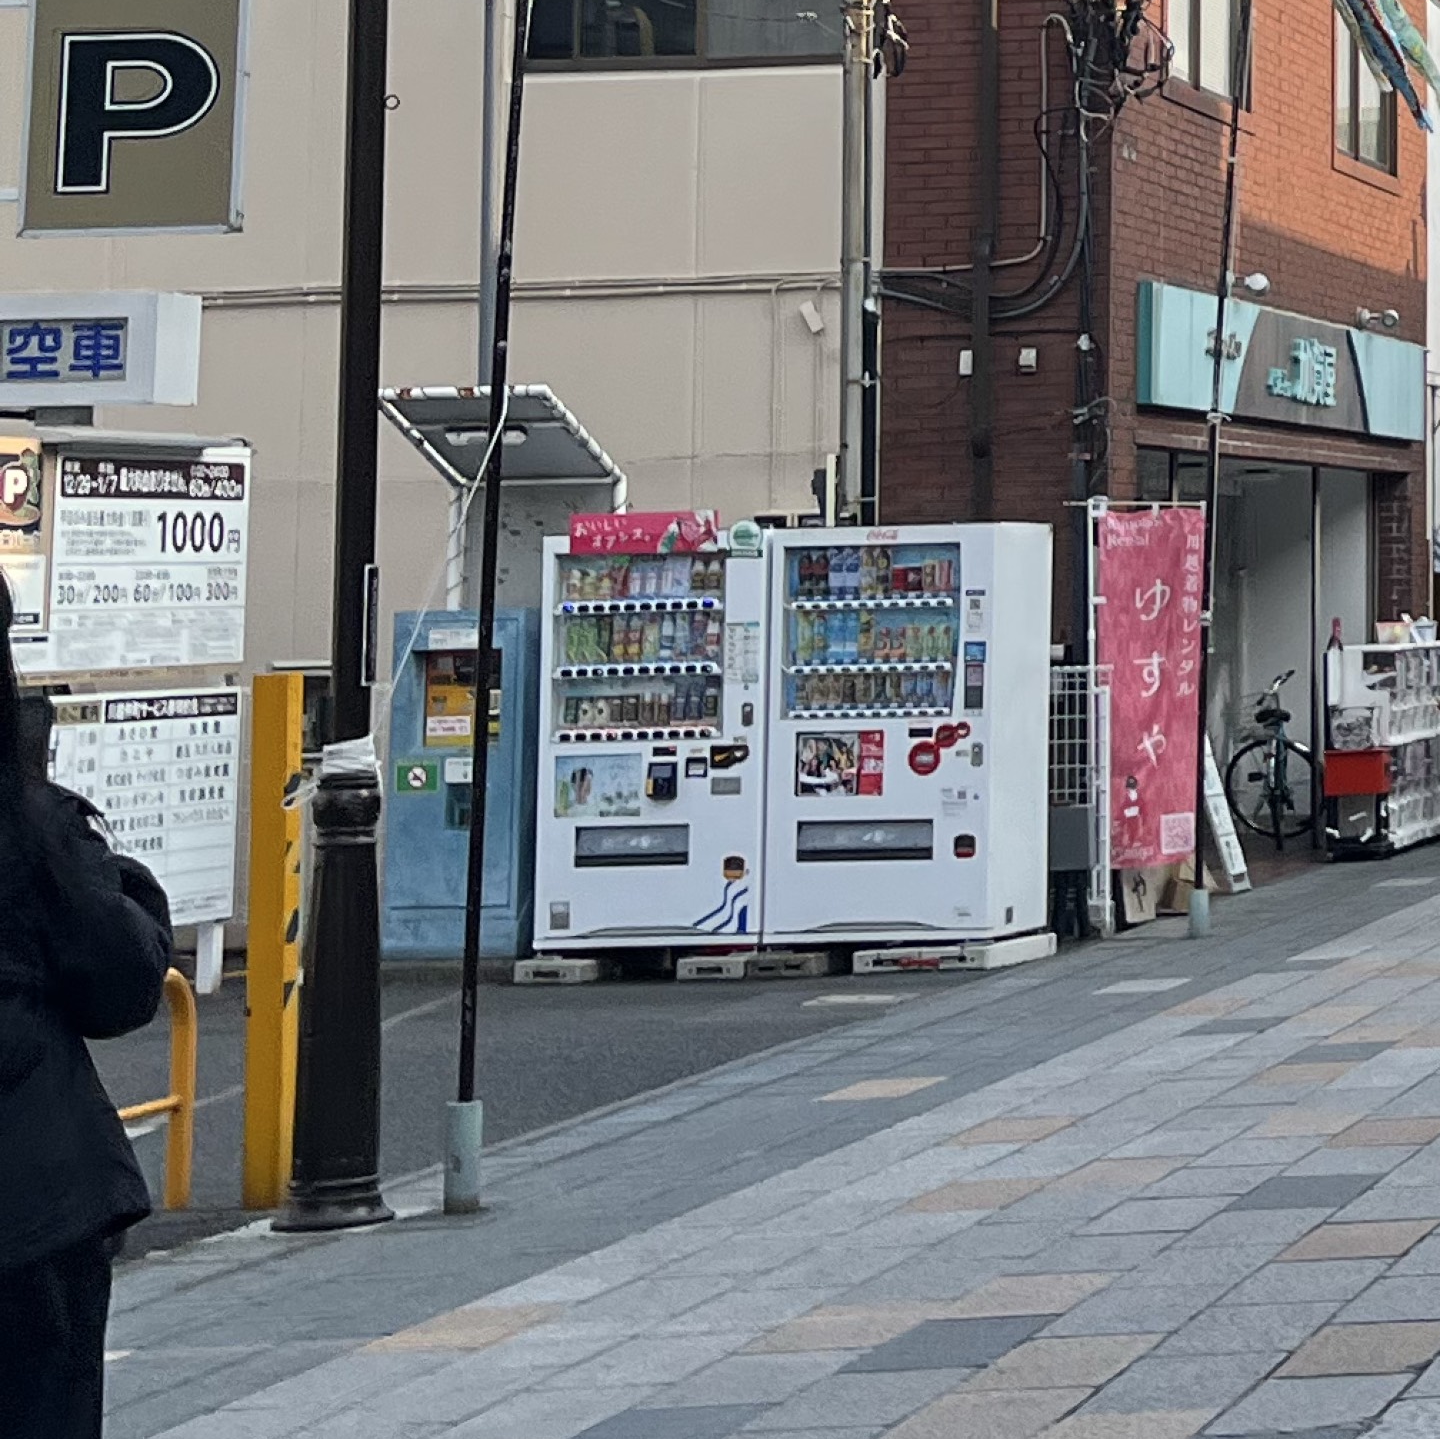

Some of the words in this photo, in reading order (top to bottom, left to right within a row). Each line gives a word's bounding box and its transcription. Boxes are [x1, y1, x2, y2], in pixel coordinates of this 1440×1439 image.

[54, 32, 220, 194] P
[6, 322, 124, 379] 空車
[5, 469, 28, 504] P
[157, 511, 241, 554] 1000円
[1133, 578, 1171, 770] ゆすや
